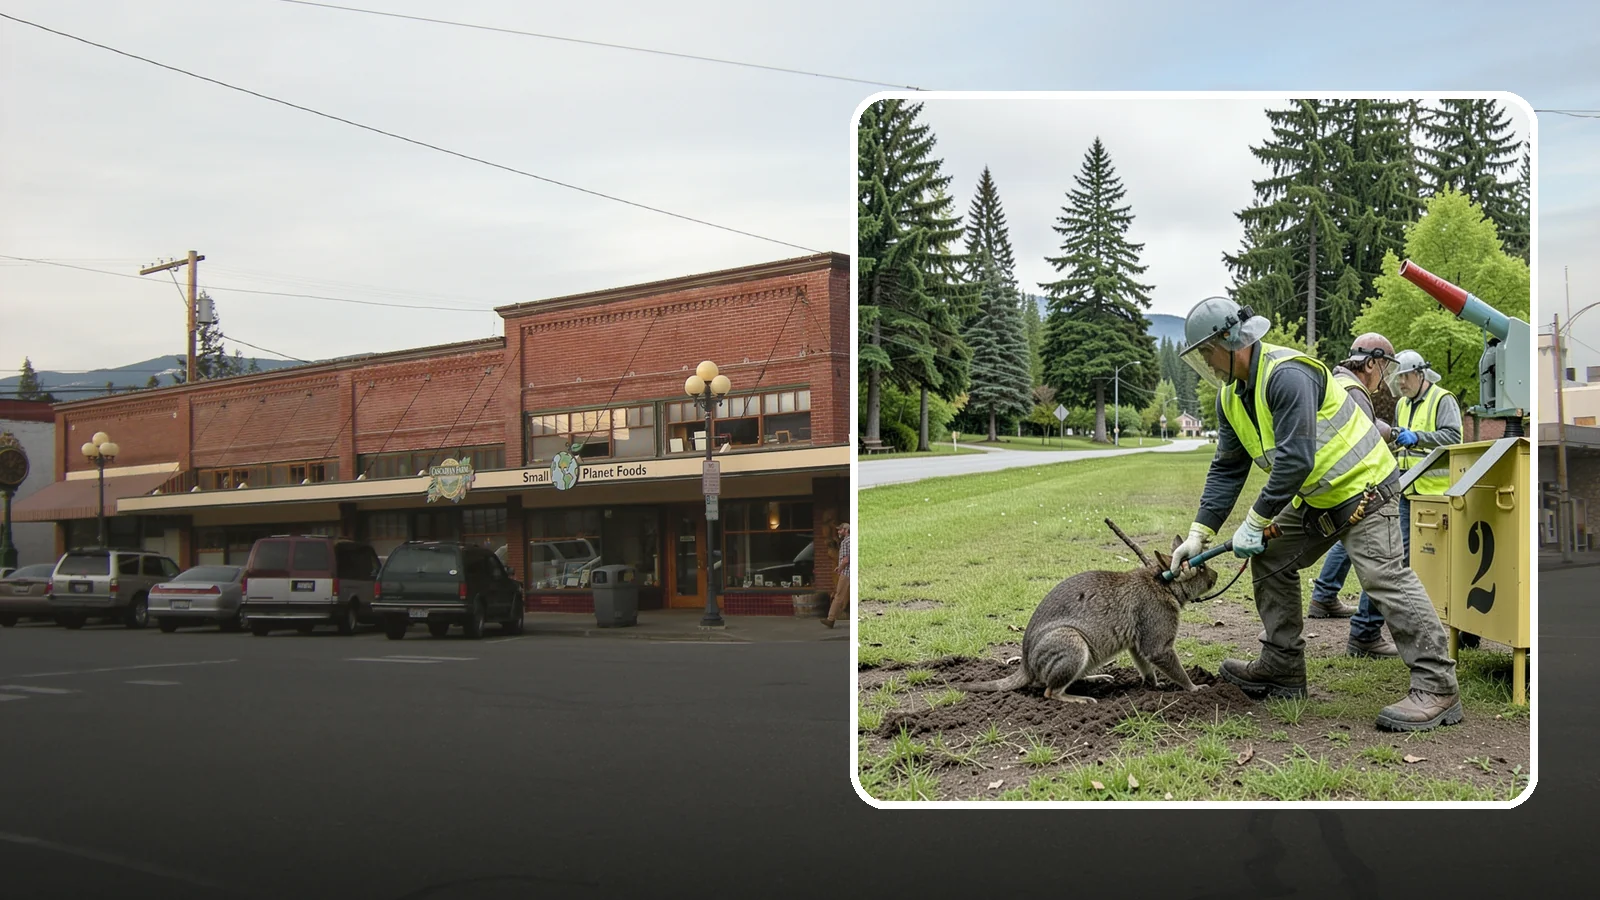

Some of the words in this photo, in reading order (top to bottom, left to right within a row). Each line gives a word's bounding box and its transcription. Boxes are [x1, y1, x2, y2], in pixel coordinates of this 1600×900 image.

[523, 471, 549, 483] Small
[583, 467, 614, 479] Planet
[617, 464, 647, 477] Foods
[1466, 520, 1496, 614] 2
